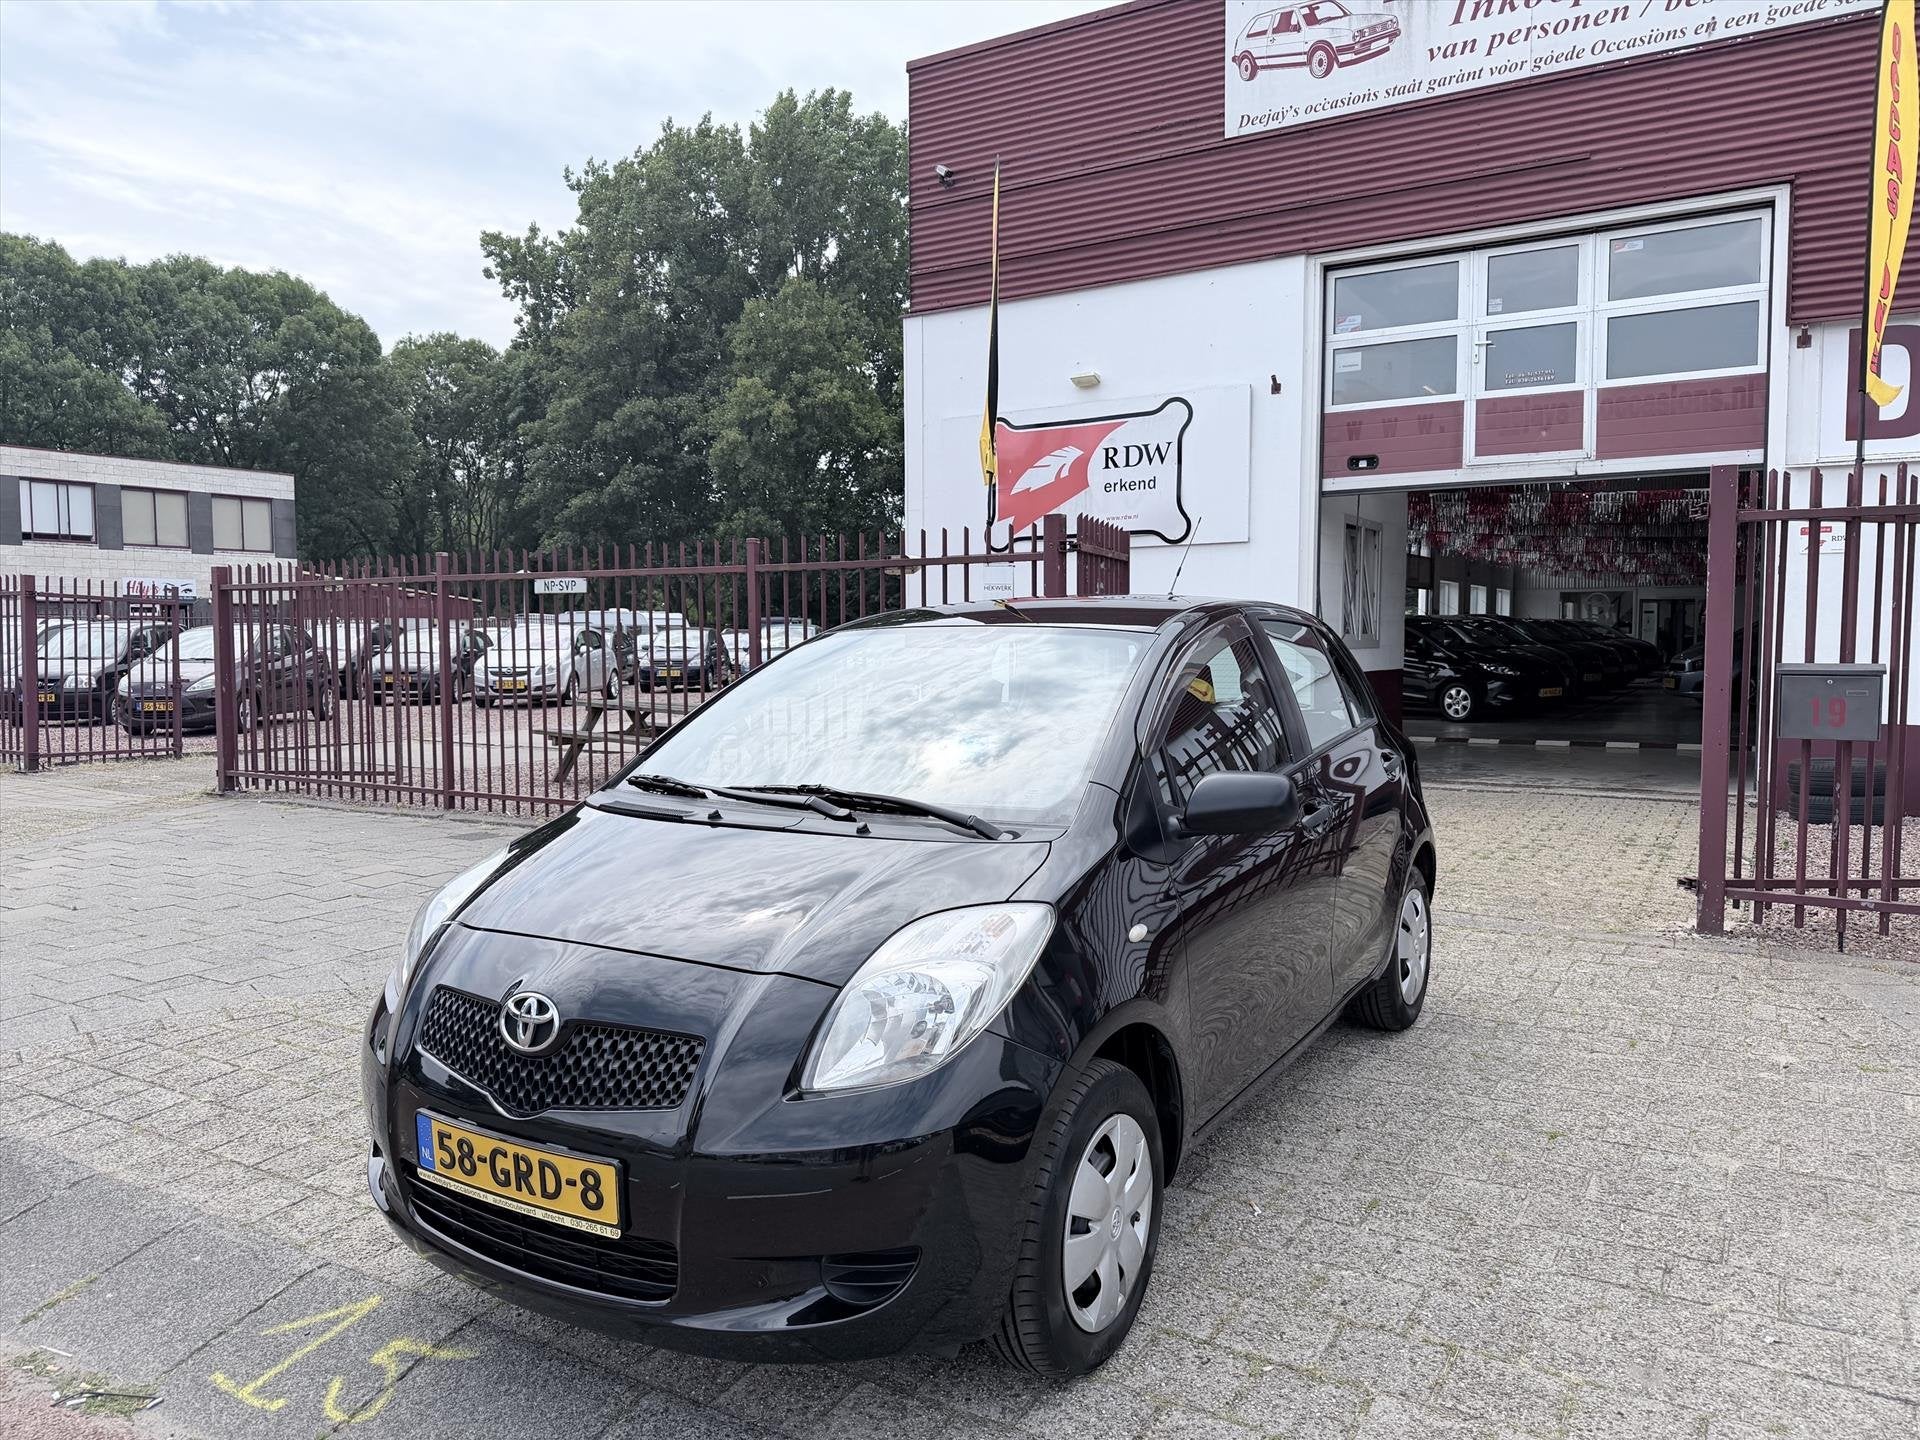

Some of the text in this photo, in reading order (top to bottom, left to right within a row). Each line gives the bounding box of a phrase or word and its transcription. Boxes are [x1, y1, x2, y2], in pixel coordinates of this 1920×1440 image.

[1427, 38, 1477, 63] van
[1485, 5, 1630, 56] personen
[1239, 0, 1826, 129] Deejay's occasions staat garant voor goede Occasions en een goede
[1102, 441, 1173, 470] RDW
[1103, 476, 1157, 493] erkend
[543, 580, 577, 592] NP-SVP
[1809, 696, 1847, 728] 19
[421, 1129, 604, 1211] NL 58-GRD-8
[492, 1197, 537, 1216] autoboulevard
[570, 1218, 599, 1233] 030-265
